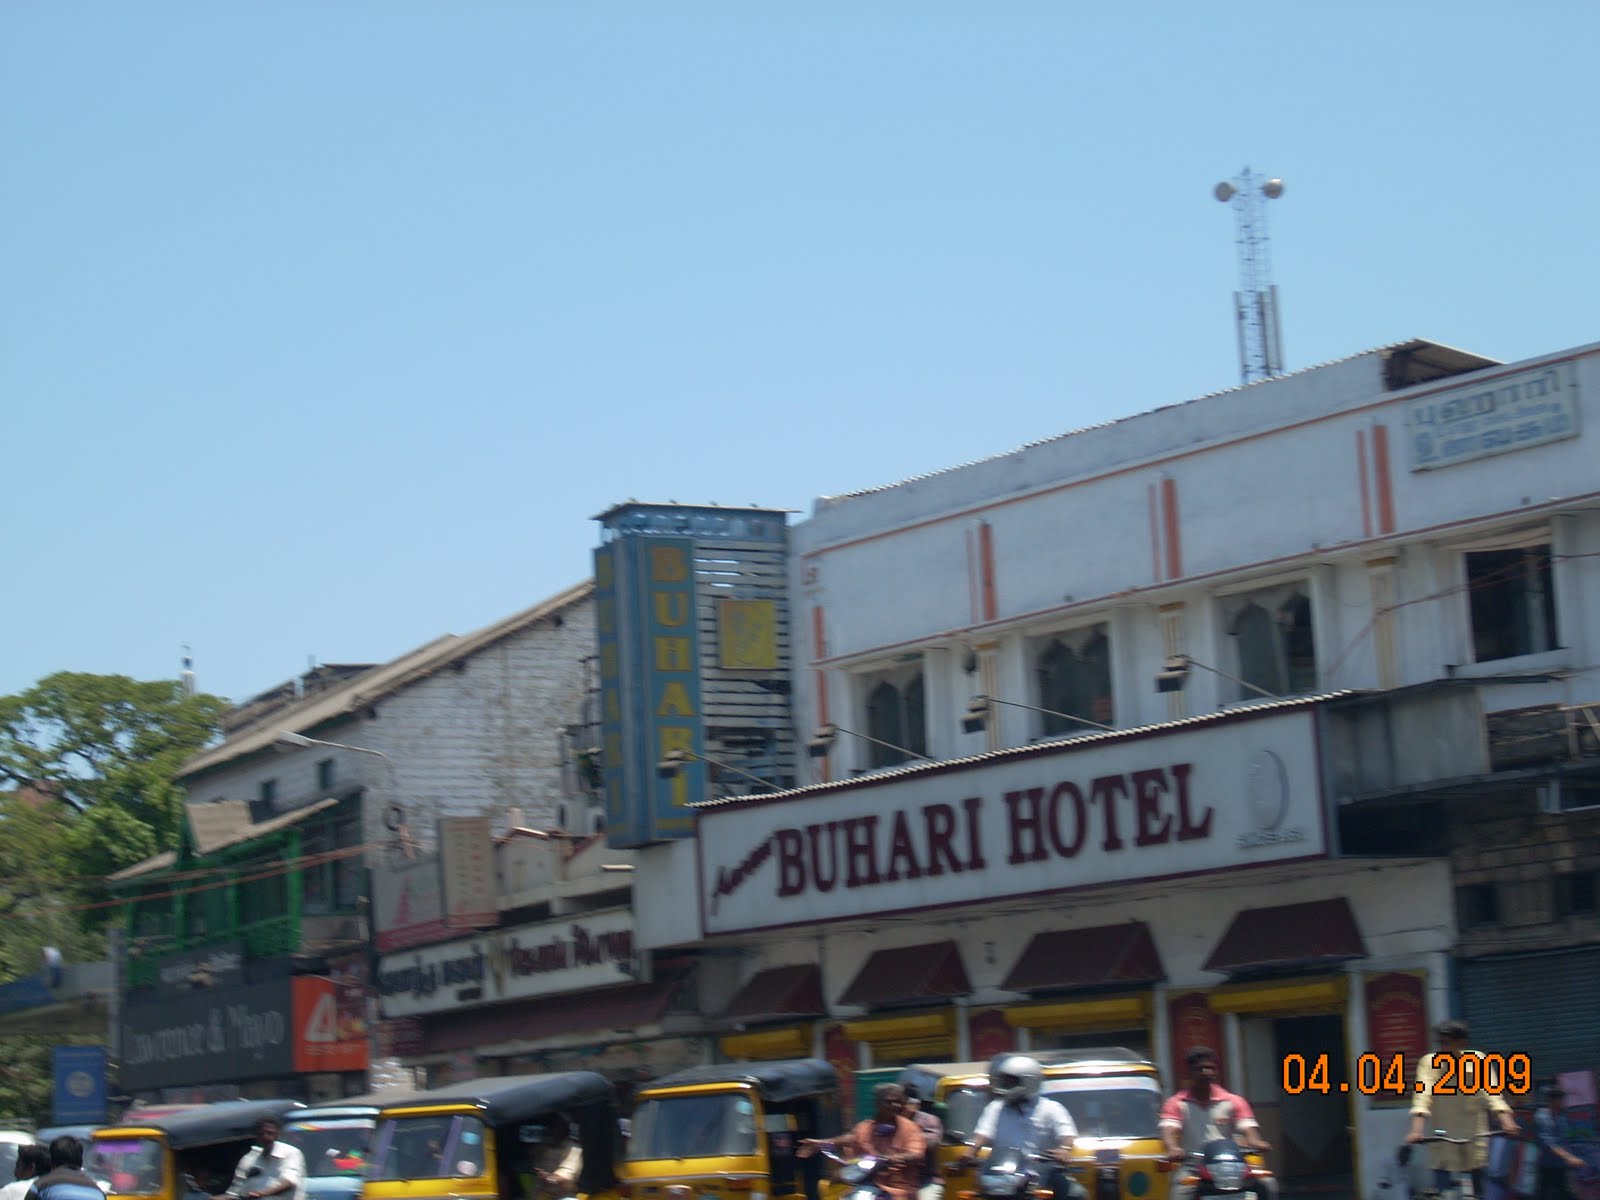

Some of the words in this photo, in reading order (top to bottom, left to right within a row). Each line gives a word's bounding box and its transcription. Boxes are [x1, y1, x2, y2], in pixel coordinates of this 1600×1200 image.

[651, 546, 697, 808] BUHARI
[774, 797, 987, 898] BUHARI
[1008, 762, 1214, 865] HOTEL
